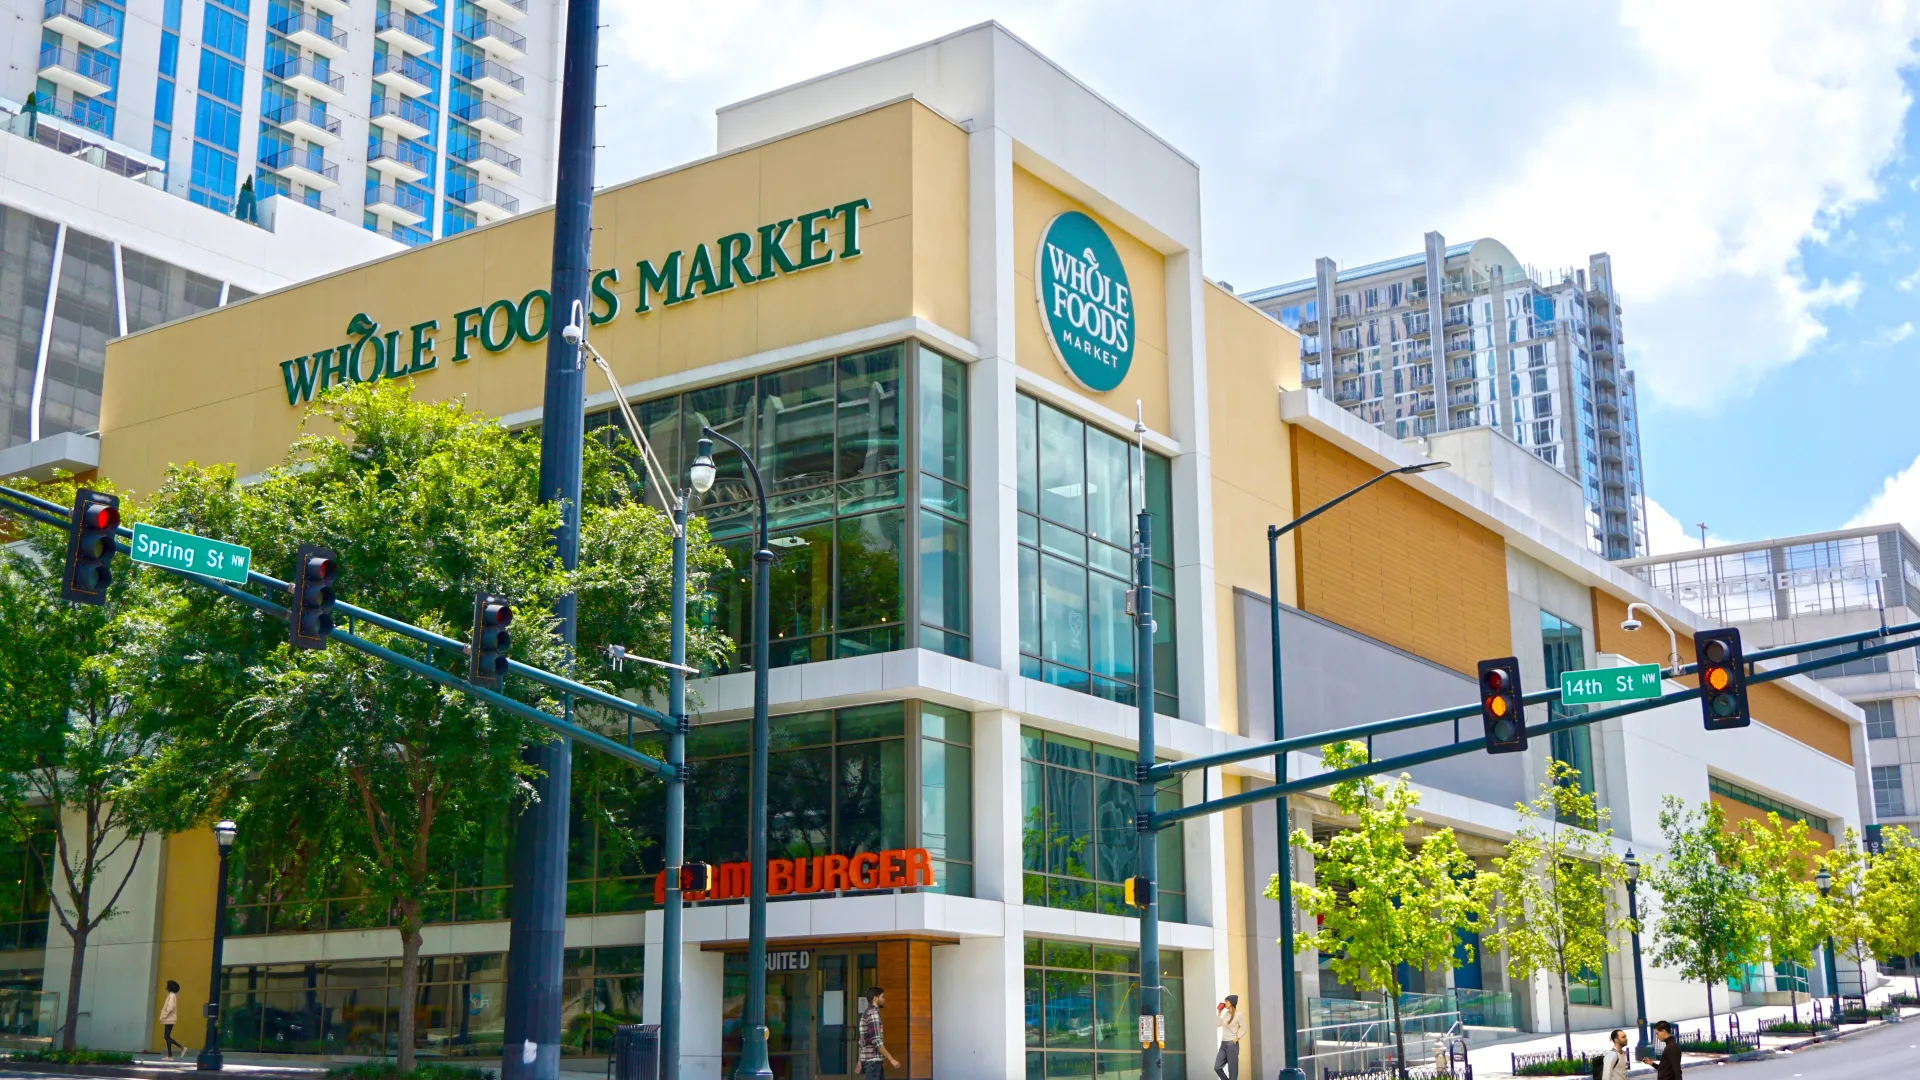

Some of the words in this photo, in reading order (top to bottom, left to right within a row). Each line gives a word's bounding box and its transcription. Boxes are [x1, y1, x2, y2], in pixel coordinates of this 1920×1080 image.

[1047, 242, 1129, 318] WHOLE
[280, 313, 441, 406] WHOLE
[453, 268, 621, 363] FOOS
[635, 198, 872, 315] MARKET
[1053, 283, 1128, 352] FOODS
[1063, 330, 1118, 368] MARKET
[137, 534, 195, 568] Spring
[206, 549, 225, 569] St
[231, 554, 246, 568] NW
[1750, 560, 1888, 592] MEDICAL
[1566, 679, 1603, 697] 14th
[1616, 675, 1634, 692] St
[1641, 672, 1656, 684] NW
[767, 848, 935, 897] BURGER
[800, 951, 810, 969] D
